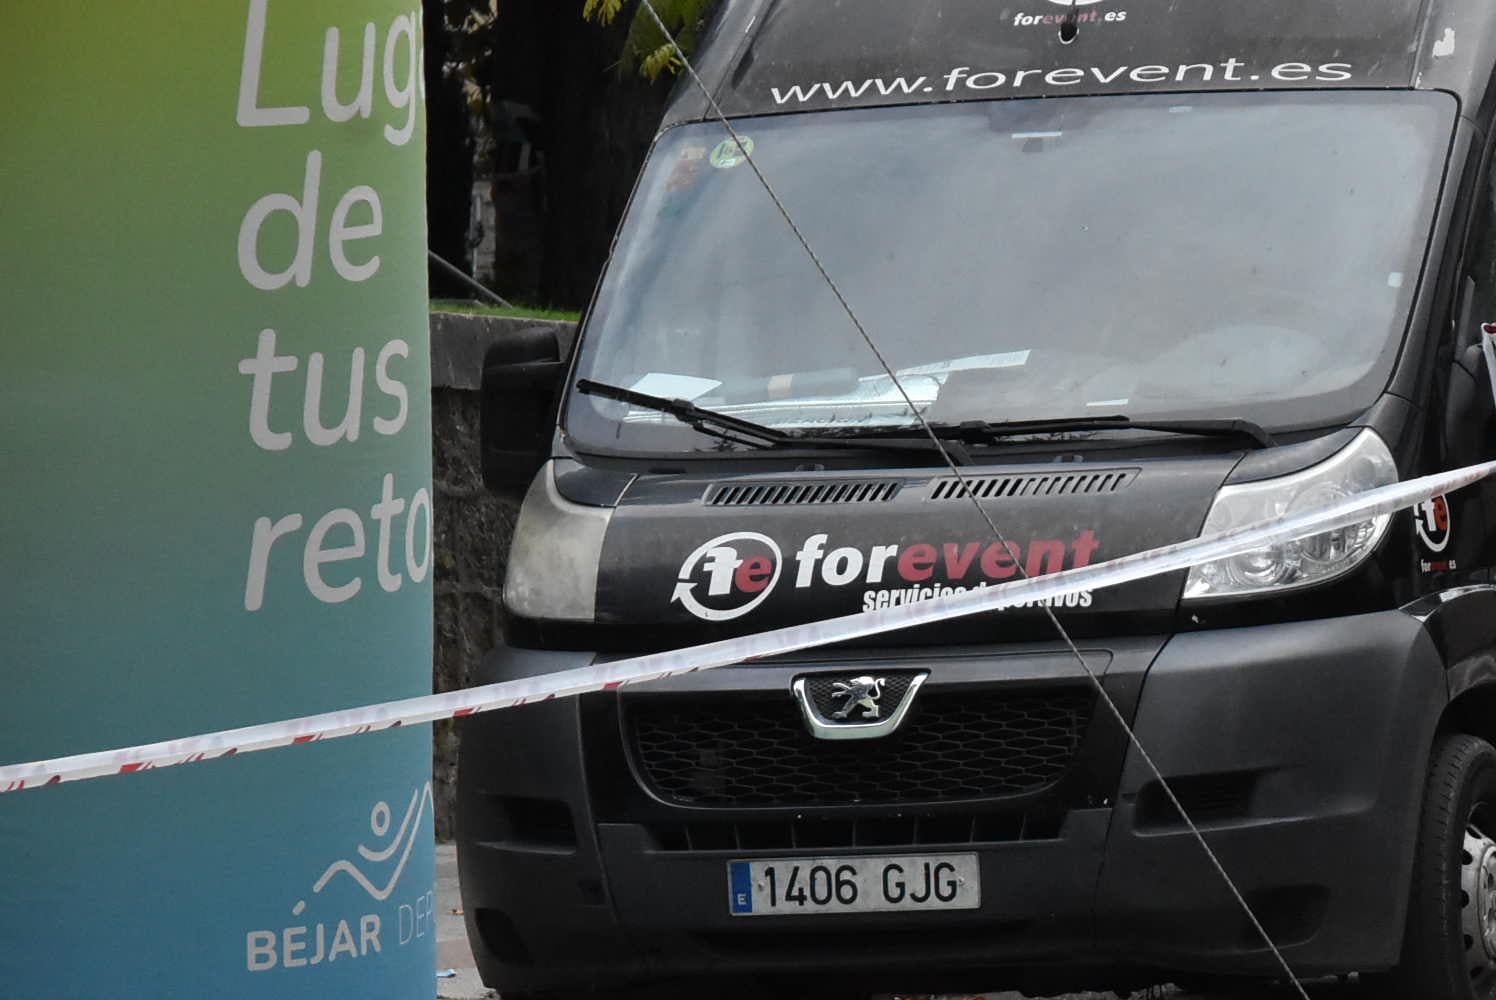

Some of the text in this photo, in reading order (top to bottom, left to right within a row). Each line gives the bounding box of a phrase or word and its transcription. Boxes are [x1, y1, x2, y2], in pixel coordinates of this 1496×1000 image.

[1013, 9, 1127, 27] forevnt.es
[236, 0, 425, 146] Lug
[770, 57, 1353, 104] www.forevent.es
[238, 150, 384, 290] de
[238, 328, 409, 451] tus
[795, 530, 1100, 588] forevent
[764, 862, 859, 908] 1406
[882, 861, 958, 904] GJG
[246, 899, 382, 972] BÉJAR
